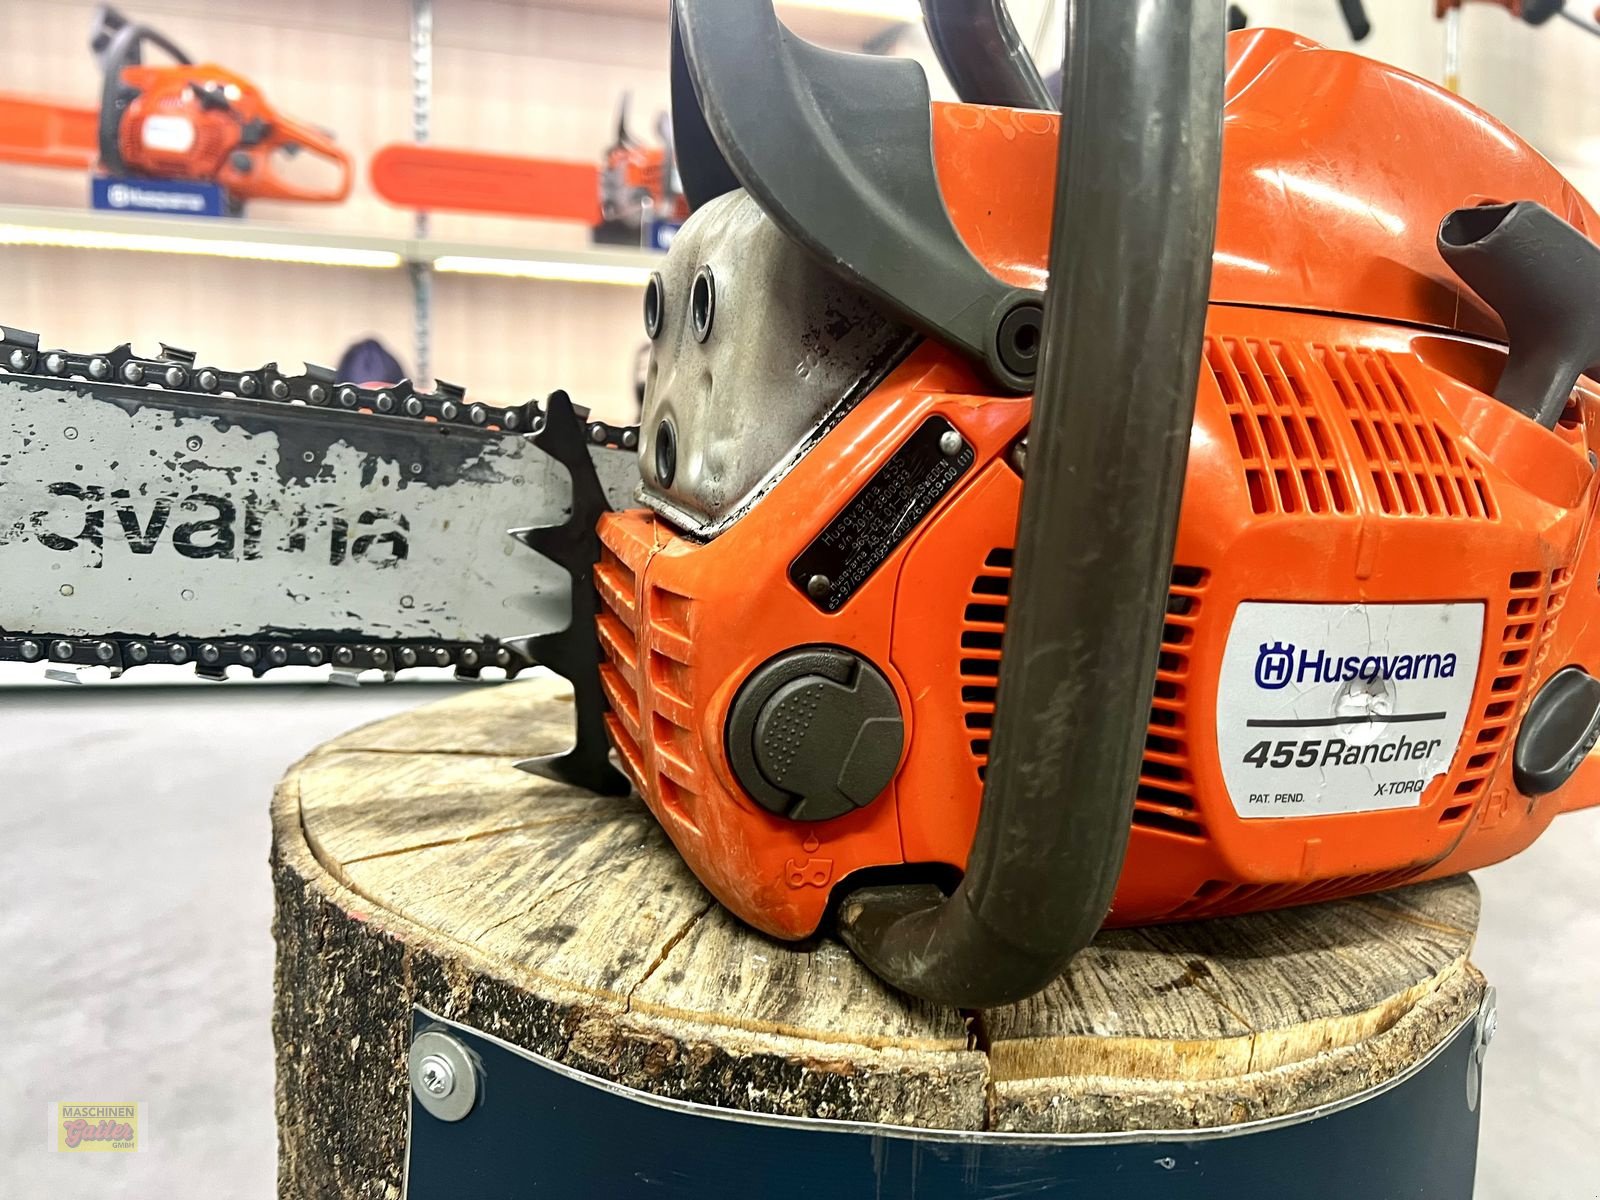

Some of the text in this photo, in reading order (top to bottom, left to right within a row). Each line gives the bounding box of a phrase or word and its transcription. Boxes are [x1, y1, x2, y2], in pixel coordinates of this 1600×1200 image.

[1297, 649, 1457, 684] Husqvarna
[1249, 779, 1424, 803] PAT. PEND. X-TORQ
